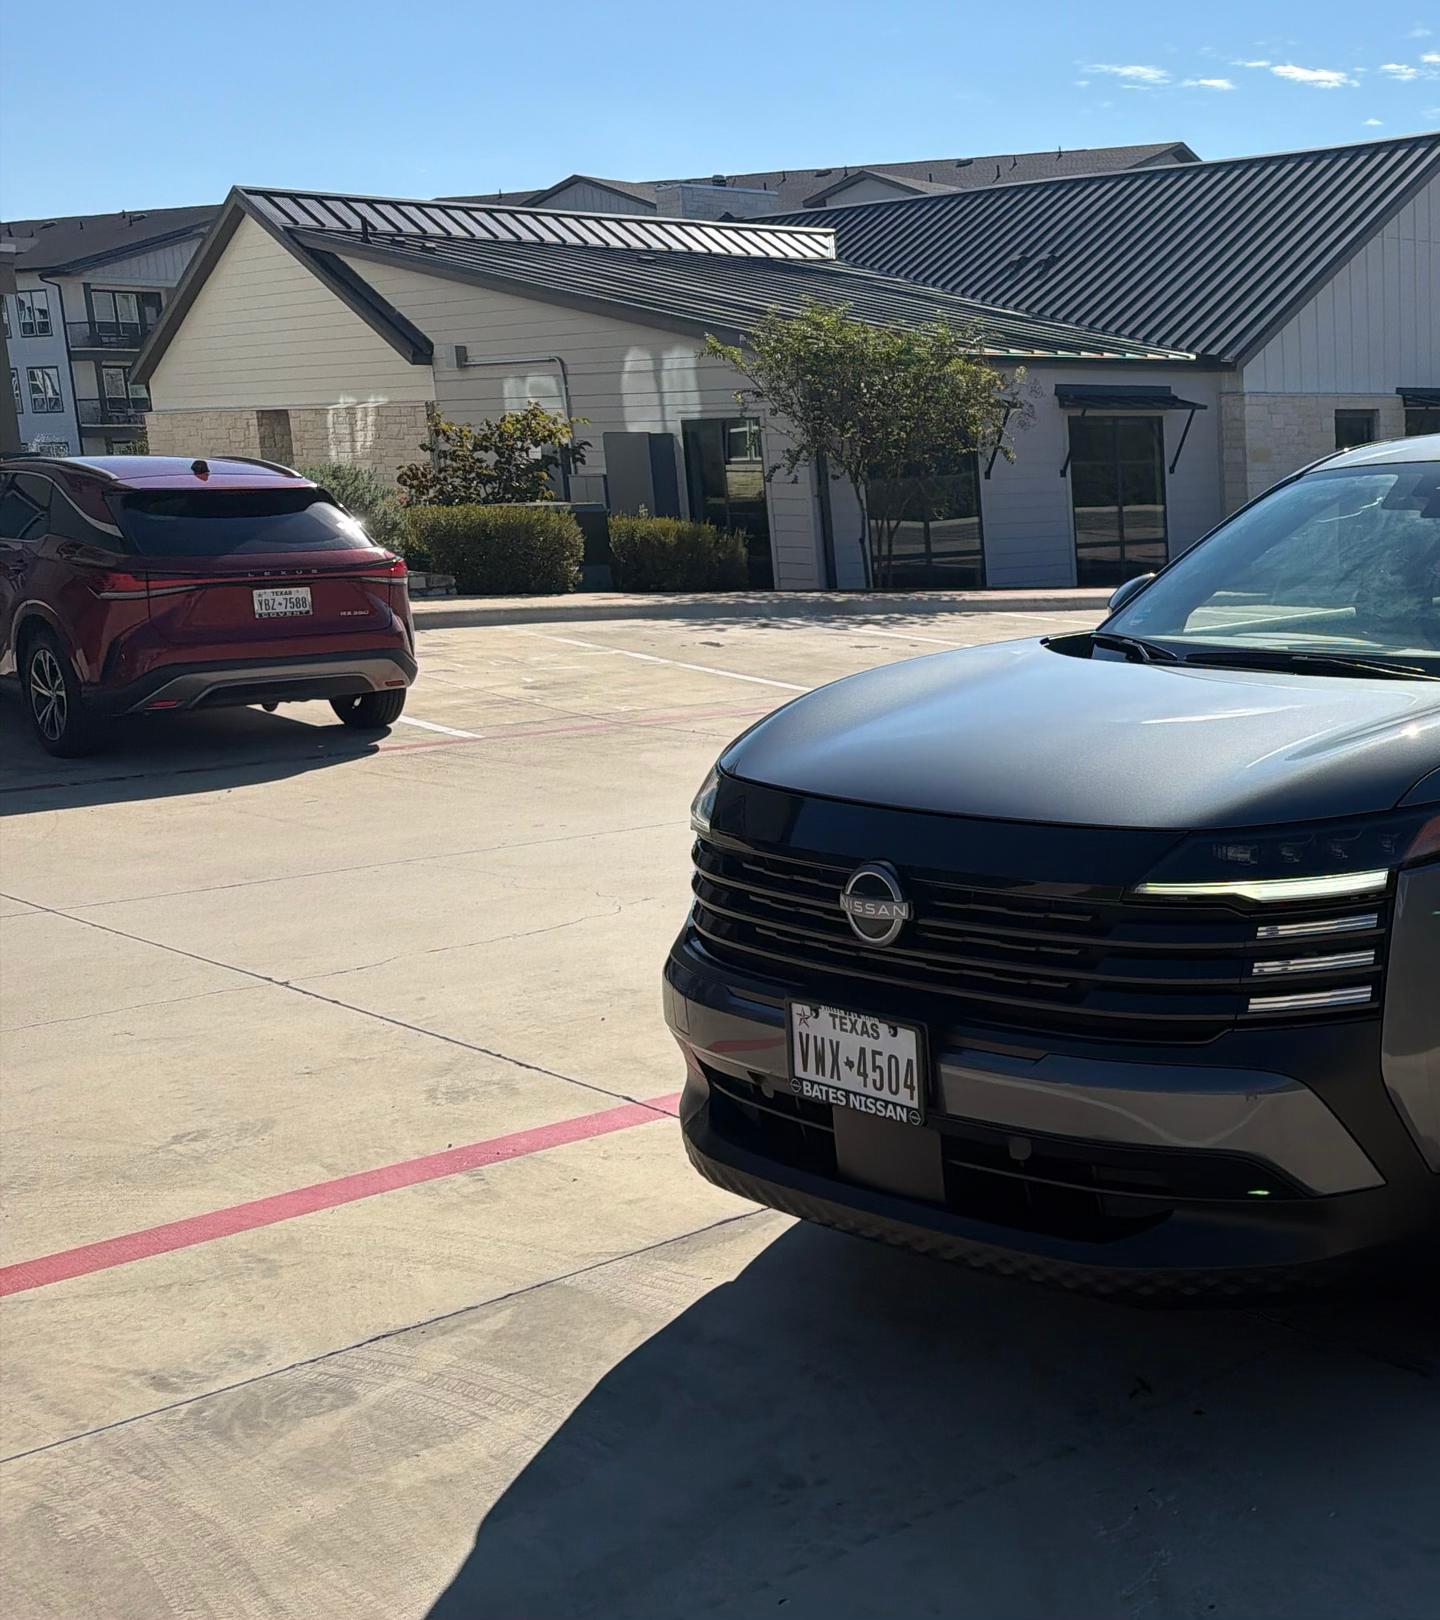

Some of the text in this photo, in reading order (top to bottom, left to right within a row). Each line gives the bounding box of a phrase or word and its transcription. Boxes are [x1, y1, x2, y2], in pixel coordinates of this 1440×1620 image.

[248, 569, 318, 577] LEXUS
[840, 894, 906, 917] NISSAN
[829, 1013, 881, 1041] TEXAS
[802, 1080, 908, 1123] BATES NISSAN
